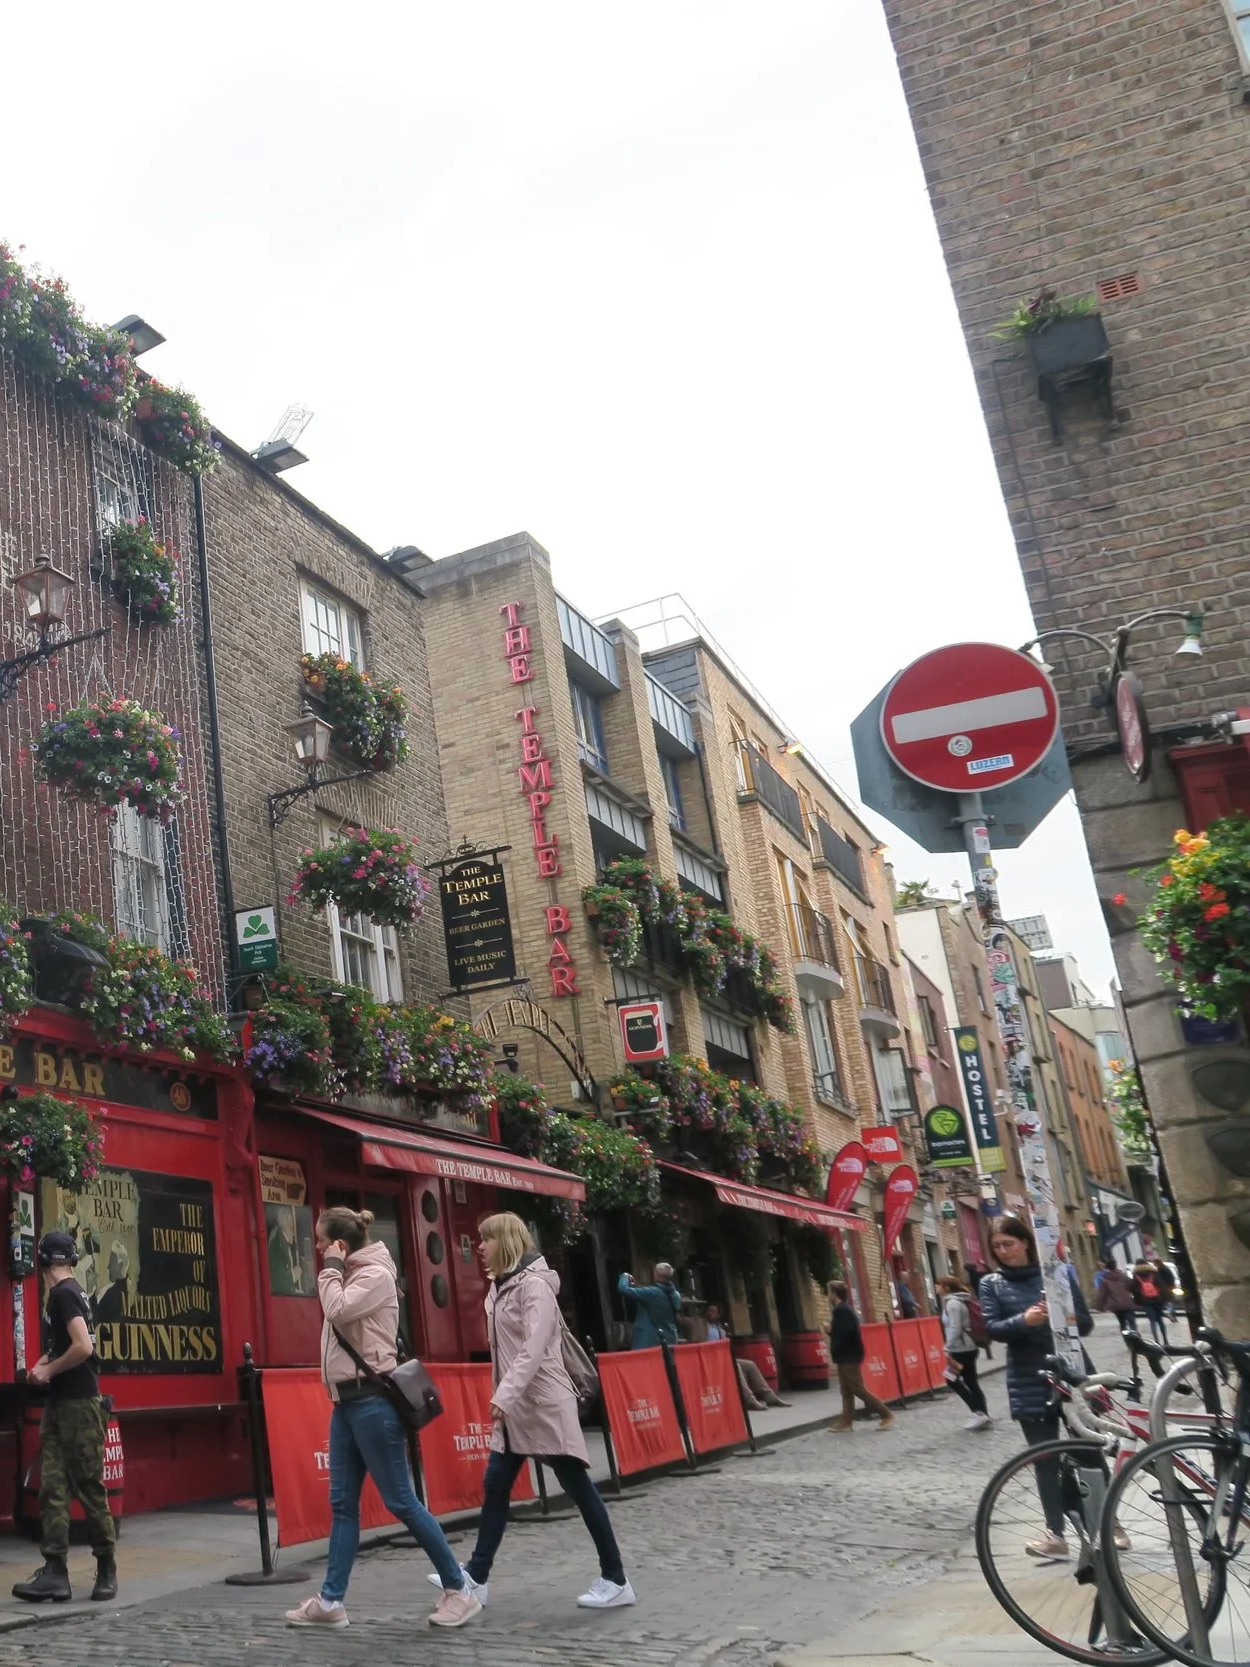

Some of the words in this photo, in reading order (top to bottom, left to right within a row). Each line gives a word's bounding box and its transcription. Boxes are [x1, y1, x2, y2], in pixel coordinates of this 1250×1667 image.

[499, 600, 533, 684] THE
[969, 755, 1011, 772] LUZERN
[514, 705, 562, 879] TEMPLE
[443, 873, 503, 894] TEMPLE
[460, 866, 481, 877] THE
[458, 891, 490, 906] BAR
[449, 924, 470, 936] BEER
[471, 917, 506, 931] GARDEN
[454, 956, 475, 967] LIVE
[476, 950, 507, 964] MUSIC
[543, 904, 581, 997] BAR
[467, 962, 496, 975] DAILY
[34, 1052, 106, 1096] BAR
[964, 1055, 992, 1141] HOSTEL
[435, 1159, 456, 1175] THE
[457, 1162, 493, 1182] TEMPLE
[494, 1169, 512, 1186] BAR
[80, 1179, 136, 1200] EMPLE
[93, 1198, 123, 1222] BAR
[180, 1203, 203, 1229] THE
[152, 1227, 205, 1256] EMPEROR
[193, 1260, 206, 1283] OF
[121, 1291, 168, 1320] MALTED
[169, 1285, 211, 1317] LIQUORS
[94, 1322, 217, 1361] GUINNESS
[107, 1427, 120, 1442] HE
